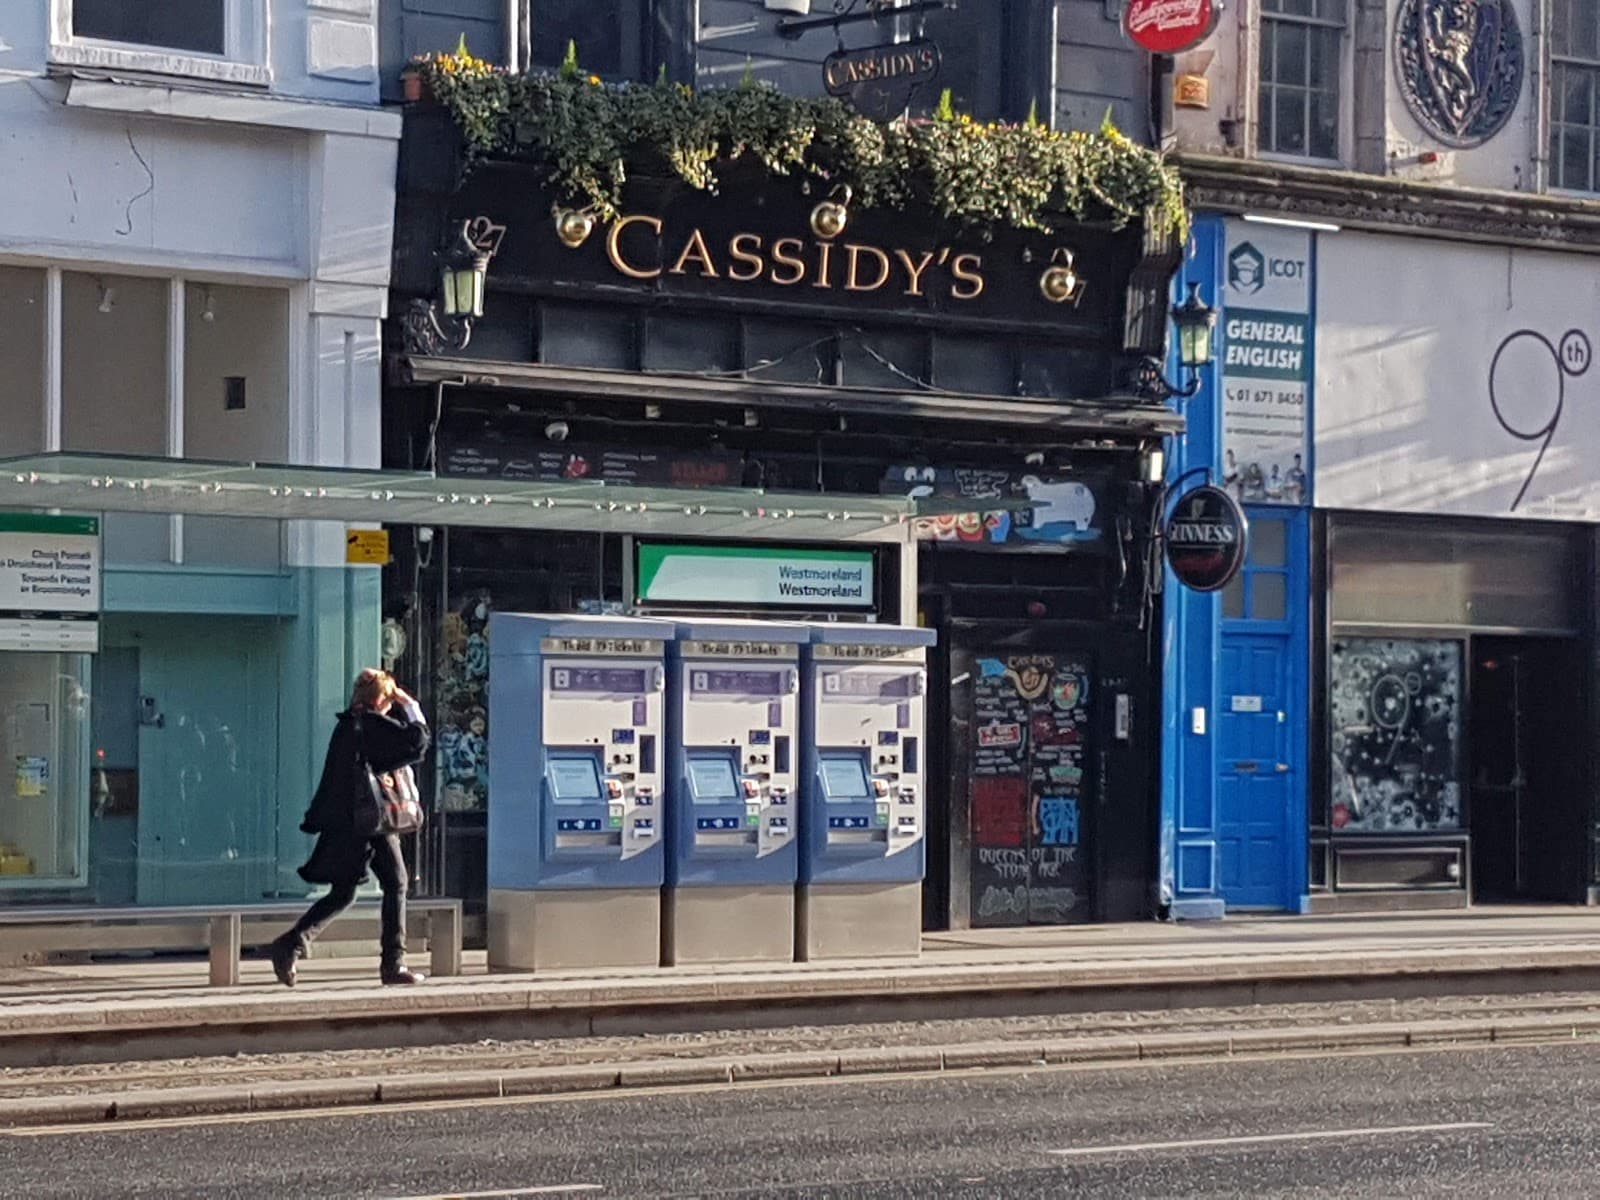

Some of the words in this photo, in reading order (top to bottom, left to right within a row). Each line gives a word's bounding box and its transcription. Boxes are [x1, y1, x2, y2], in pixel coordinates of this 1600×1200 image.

[827, 48, 934, 89] CASSIDY'S
[606, 213, 985, 300] CASSIDY'S
[1269, 258, 1305, 279] ICOT
[1226, 319, 1305, 345] GENERAL
[1225, 345, 1302, 370] ENGLISH
[1236, 389, 1250, 401] 01
[779, 566, 863, 581] Westmoreland
[779, 582, 863, 597] Westmoreland
